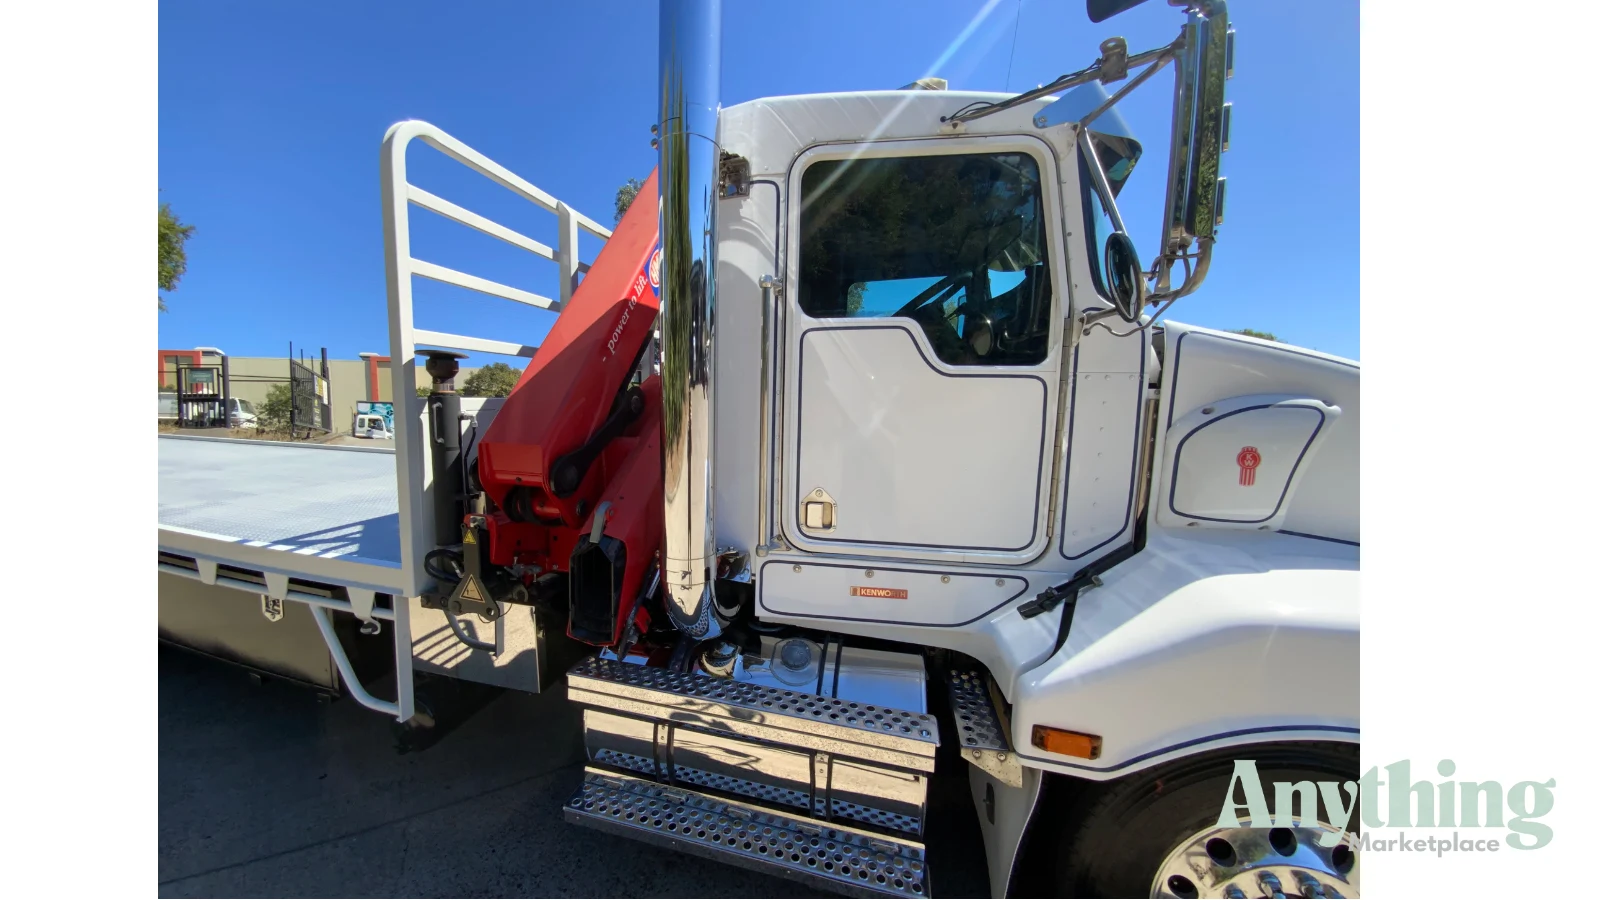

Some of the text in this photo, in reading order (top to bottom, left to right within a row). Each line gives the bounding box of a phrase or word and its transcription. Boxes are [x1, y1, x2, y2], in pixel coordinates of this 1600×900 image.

[607, 307, 630, 356] power
[628, 295, 638, 309] to
[861, 588, 906, 598] KENWORTH
